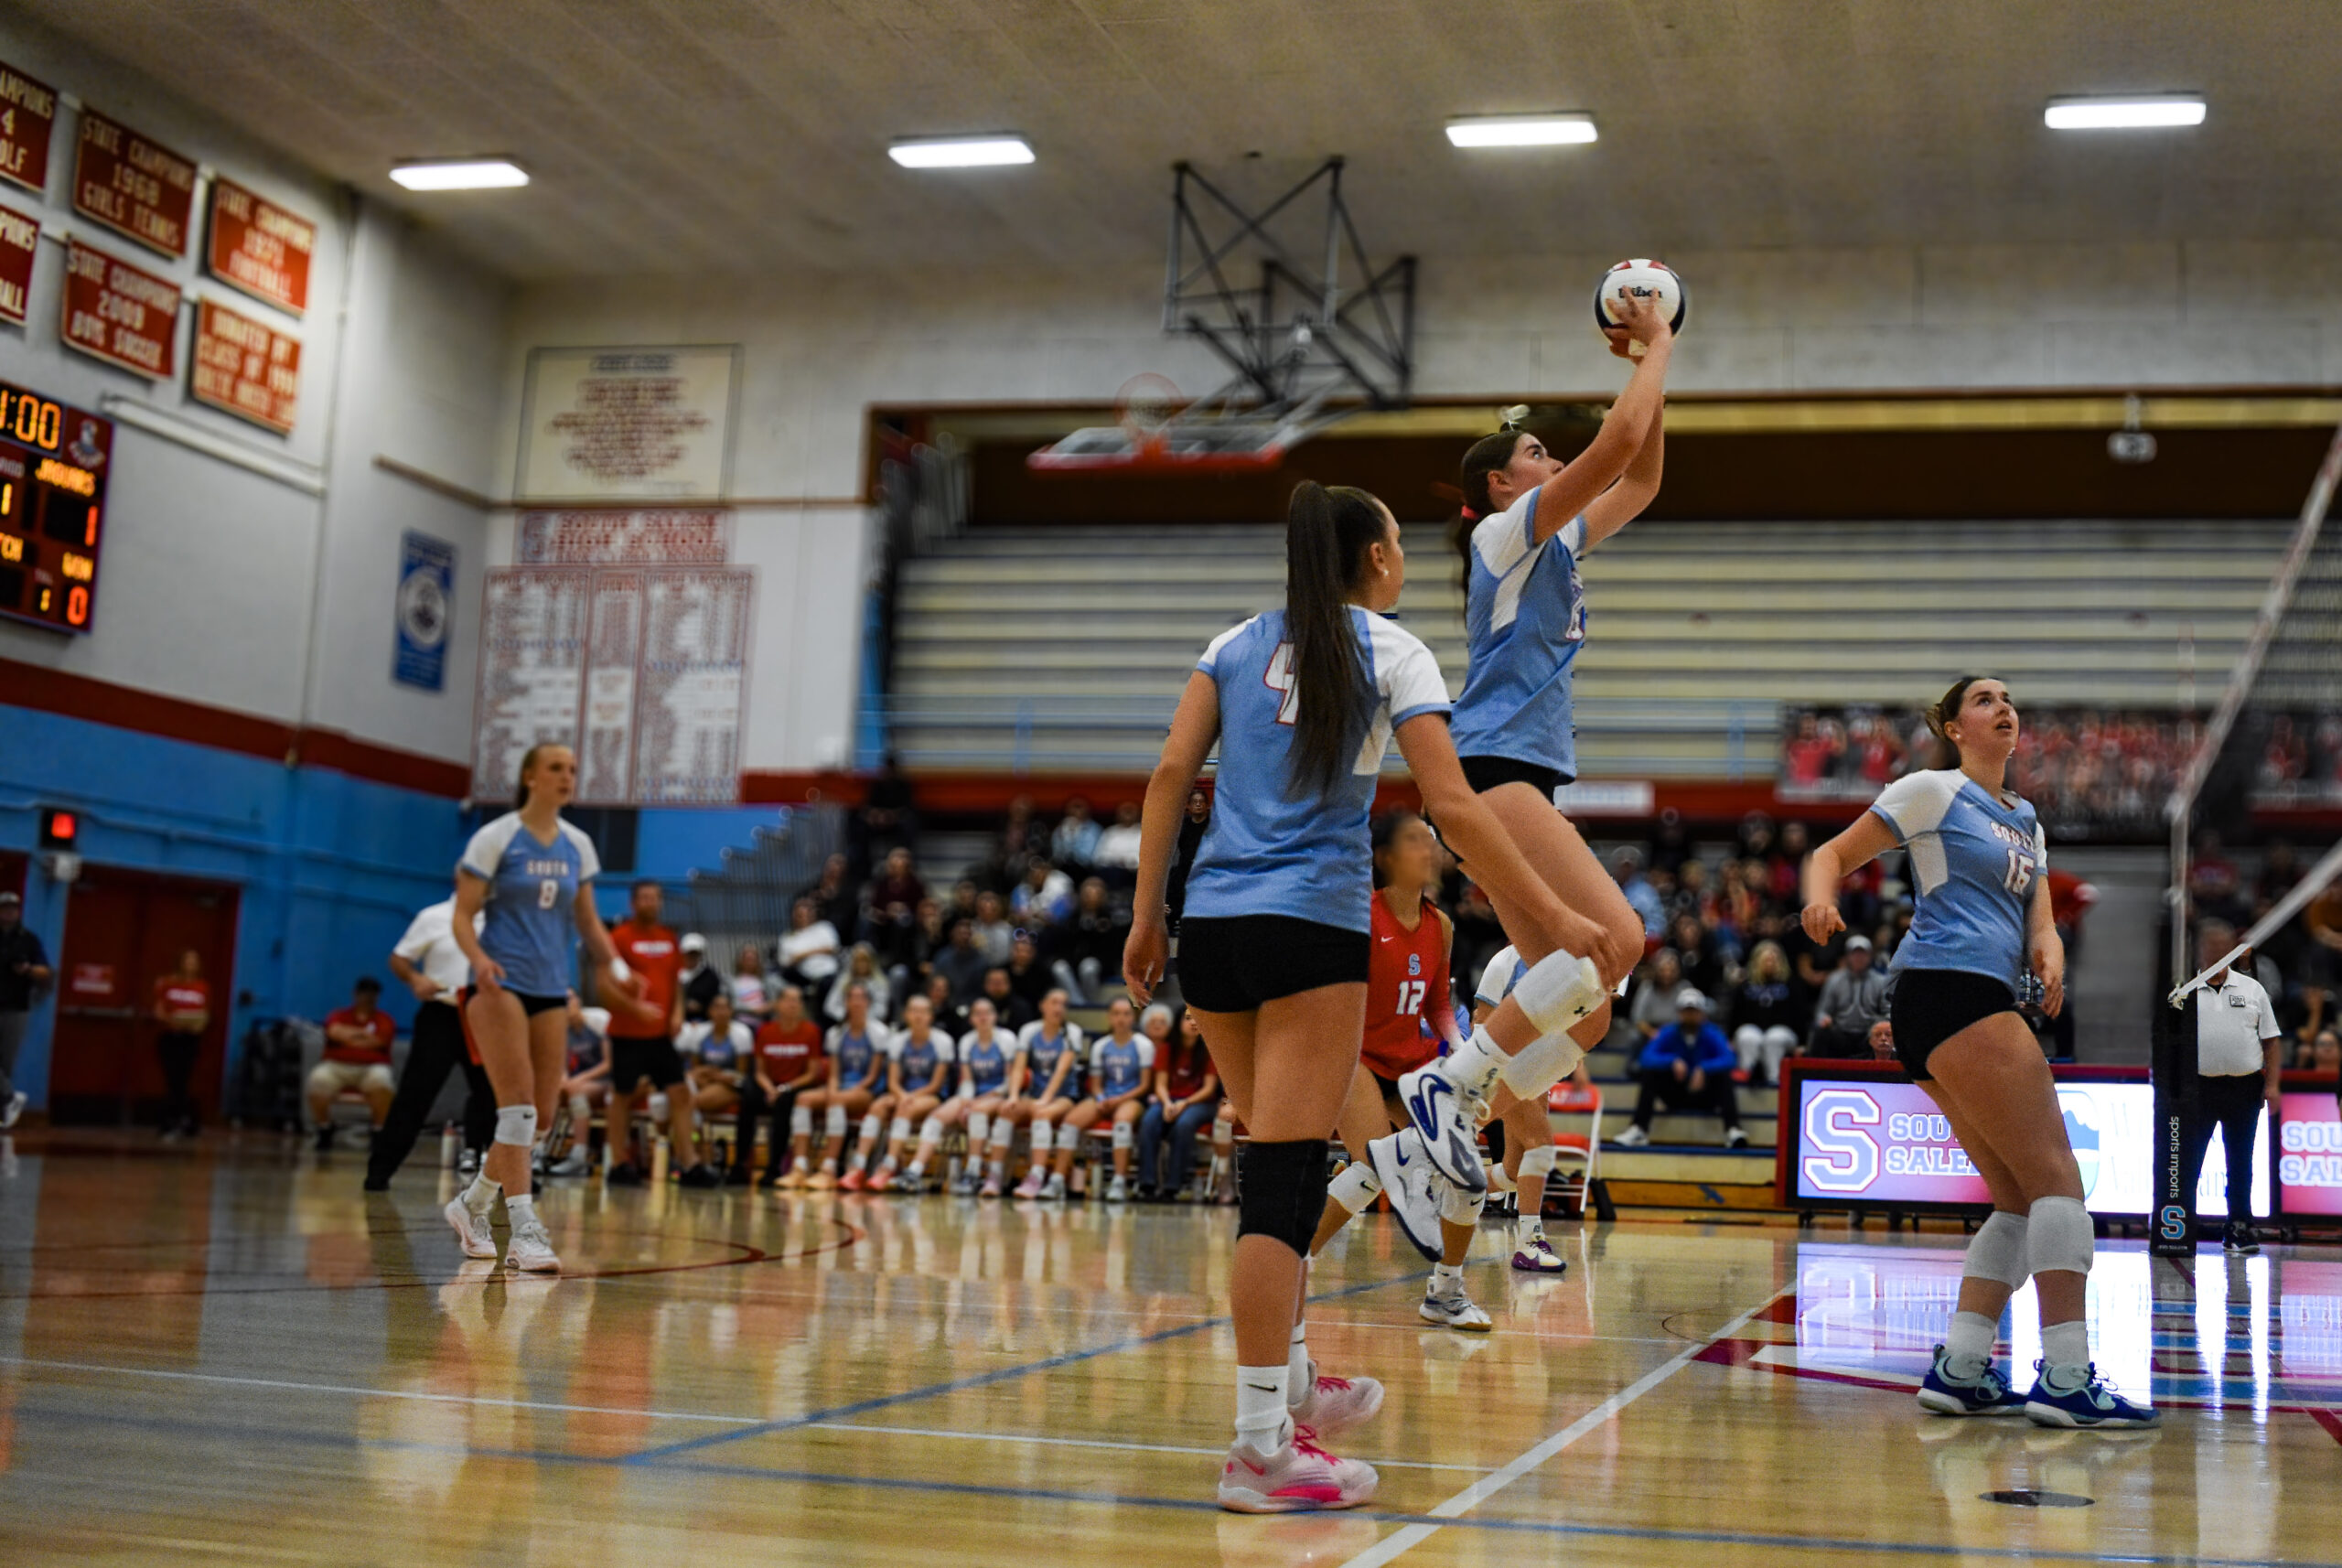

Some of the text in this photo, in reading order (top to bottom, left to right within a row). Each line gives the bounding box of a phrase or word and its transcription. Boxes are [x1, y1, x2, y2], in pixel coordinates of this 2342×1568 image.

[84, 506, 98, 547] 1
[67, 585, 89, 625] 0
[1263, 640, 1299, 725] 4
[1407, 953, 1421, 976] S
[1396, 980, 1426, 1015] 12
[1803, 1088, 1882, 1193] S
[1888, 1112, 1958, 1143] SOU
[2168, 1115, 2181, 1199] sports imports
[2160, 1205, 2186, 1240] S
